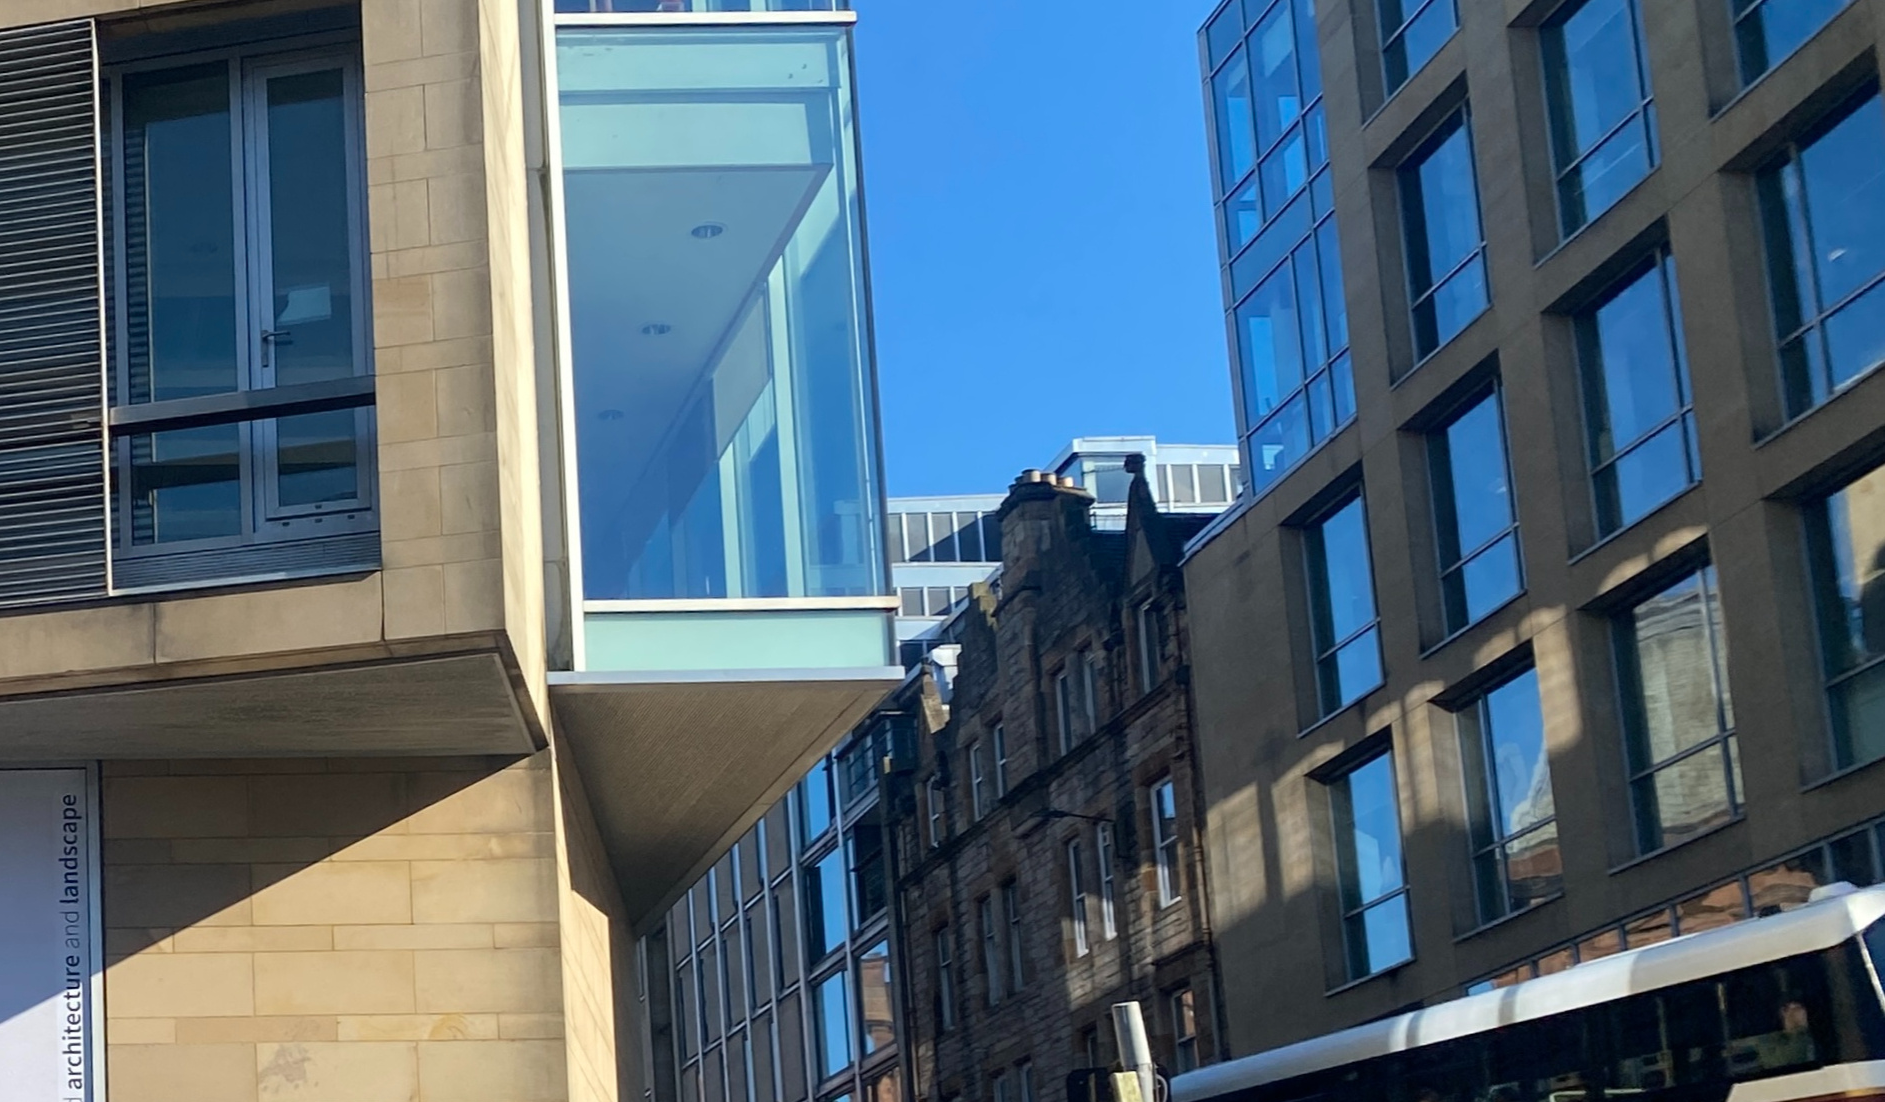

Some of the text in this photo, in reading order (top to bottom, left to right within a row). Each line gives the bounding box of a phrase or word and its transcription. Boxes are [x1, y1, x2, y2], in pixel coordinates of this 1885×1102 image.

[58, 795, 83, 904] landscape
[59, 911, 81, 949] and
[61, 955, 83, 1090] architecture
